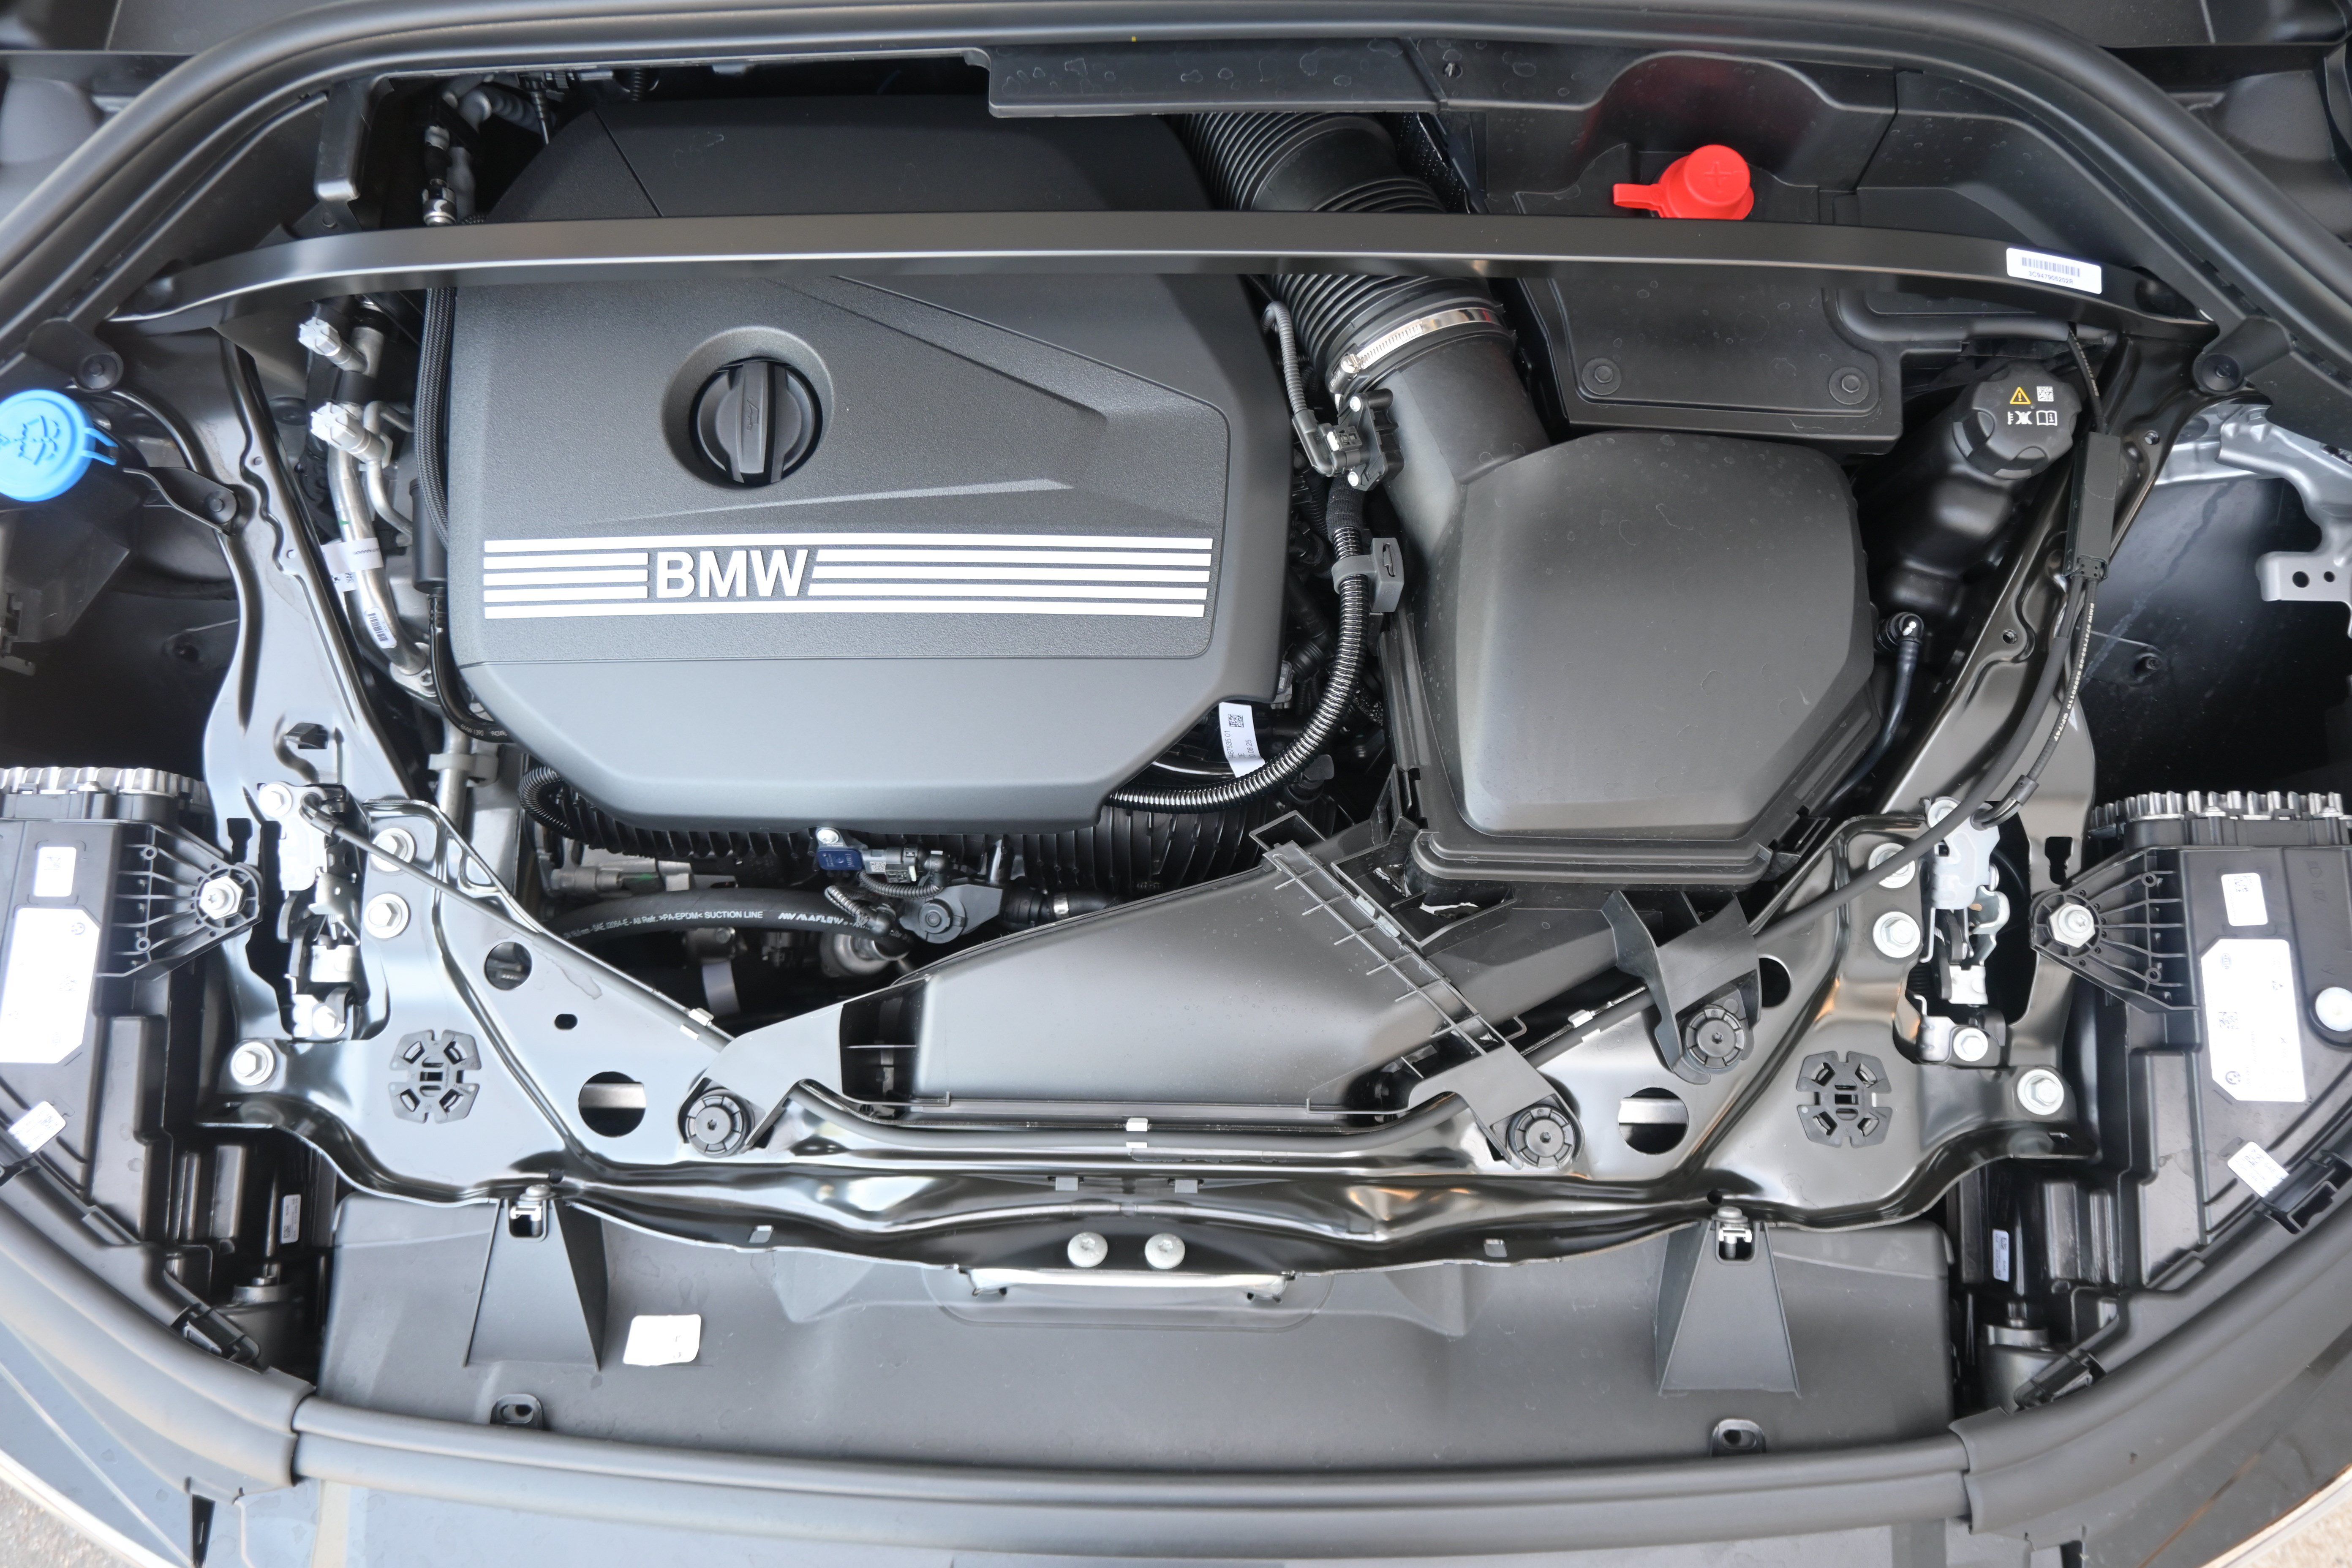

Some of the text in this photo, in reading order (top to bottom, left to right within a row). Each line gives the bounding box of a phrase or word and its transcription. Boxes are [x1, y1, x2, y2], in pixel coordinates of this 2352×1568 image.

[656, 549, 809, 598] BMW
[704, 911, 742, 919] SUCTION
[744, 911, 763, 919] LINE
